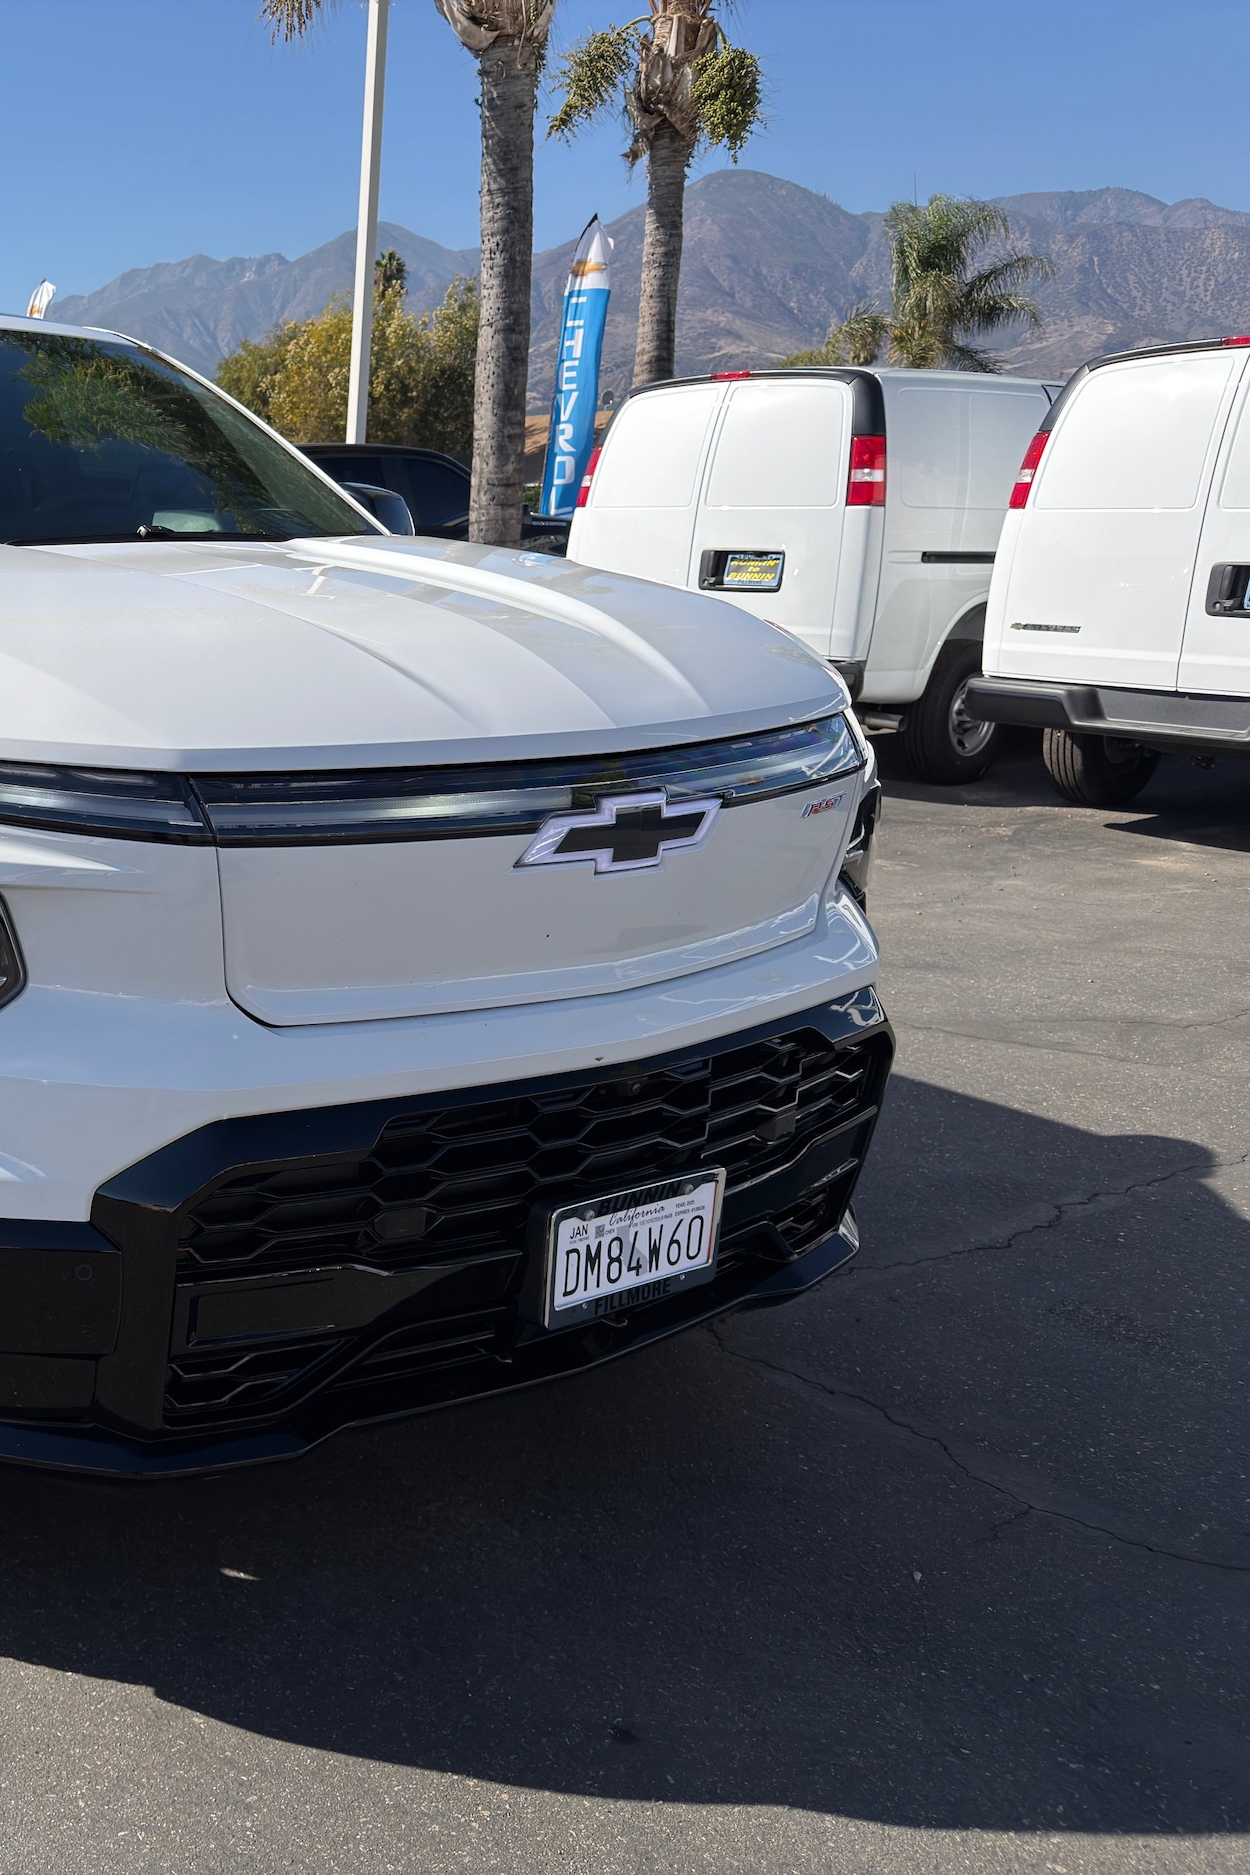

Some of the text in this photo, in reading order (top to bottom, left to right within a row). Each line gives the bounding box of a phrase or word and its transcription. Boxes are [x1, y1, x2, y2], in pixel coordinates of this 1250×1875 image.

[549, 296, 587, 517] CHEVROL
[728, 572, 775, 580] BUNNIN
[609, 1203, 665, 1228] California
[570, 1224, 588, 1239] JAN
[562, 1214, 704, 1298] DM84W60
[594, 1279, 671, 1315] FILLMORE
